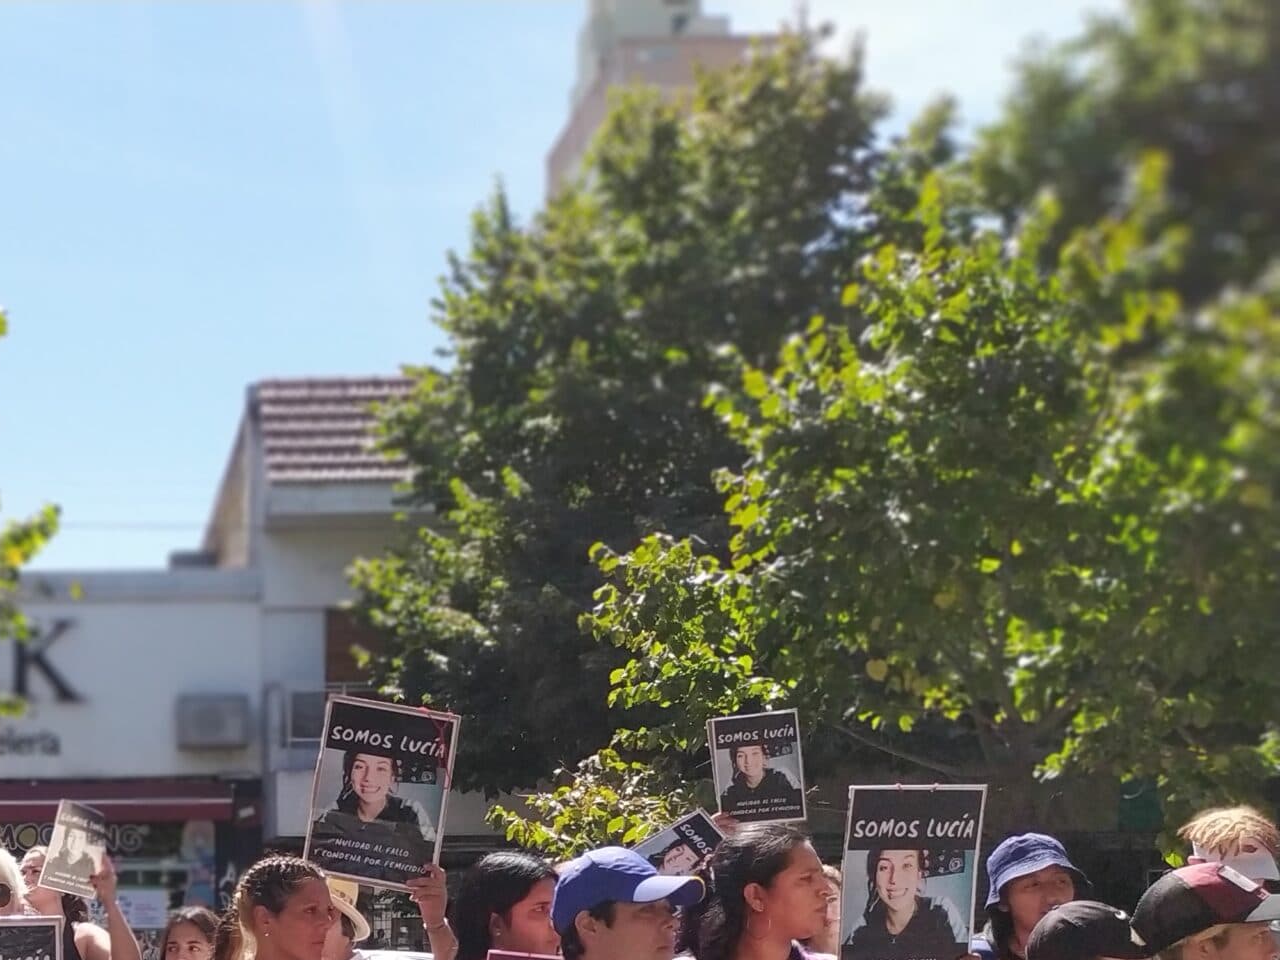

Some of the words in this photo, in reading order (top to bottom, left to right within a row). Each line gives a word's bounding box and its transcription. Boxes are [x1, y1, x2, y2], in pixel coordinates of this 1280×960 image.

[331, 725, 393, 749] SOMOS
[400, 735, 445, 759] LUCÍA
[718, 730, 759, 744] SOMOS
[764, 724, 794, 739] LUCÍA
[853, 818, 919, 838] SOMOS
[927, 812, 975, 838] LUCÍA
[335, 838, 371, 851] NULIDAD
[373, 844, 384, 853] AL
[385, 846, 409, 858] FALLO
[680, 823, 712, 855] SOMOS
[322, 850, 361, 863] CONDENA
[364, 856, 381, 866] POR
[383, 859, 427, 875] FEMICIDIO
